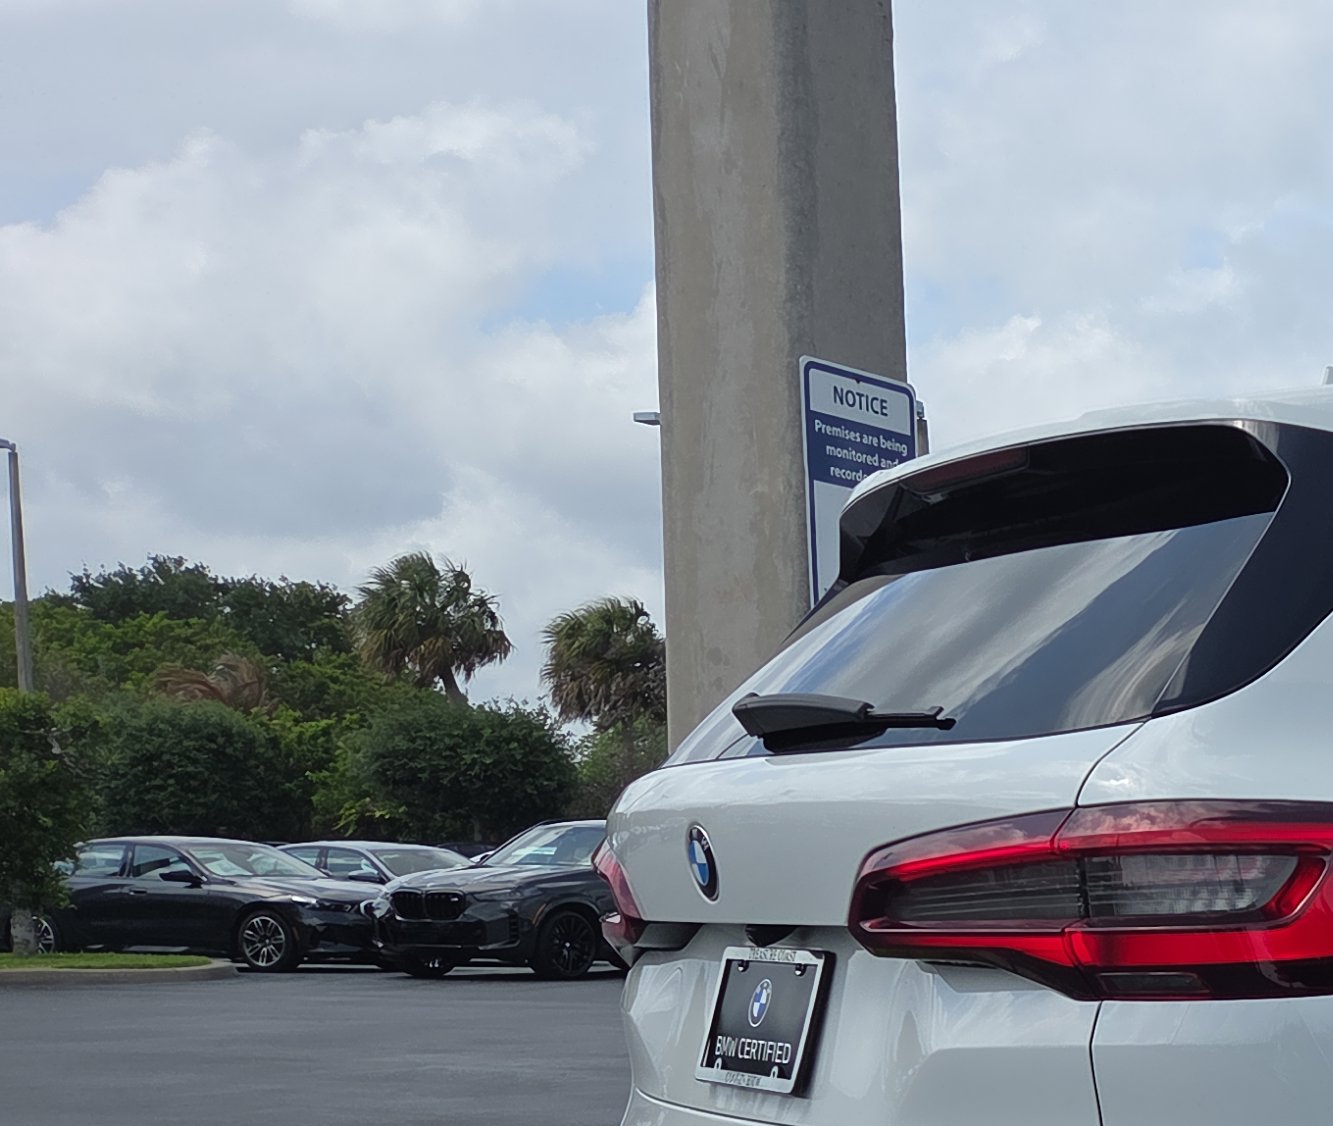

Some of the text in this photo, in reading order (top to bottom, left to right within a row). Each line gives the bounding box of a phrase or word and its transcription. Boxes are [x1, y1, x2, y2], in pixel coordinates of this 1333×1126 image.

[833, 385, 889, 417] NOTICE
[814, 419, 908, 456] Premises are being
[826, 444, 879, 466] monitored
[715, 1035, 792, 1064] BMW CERTIFIED
